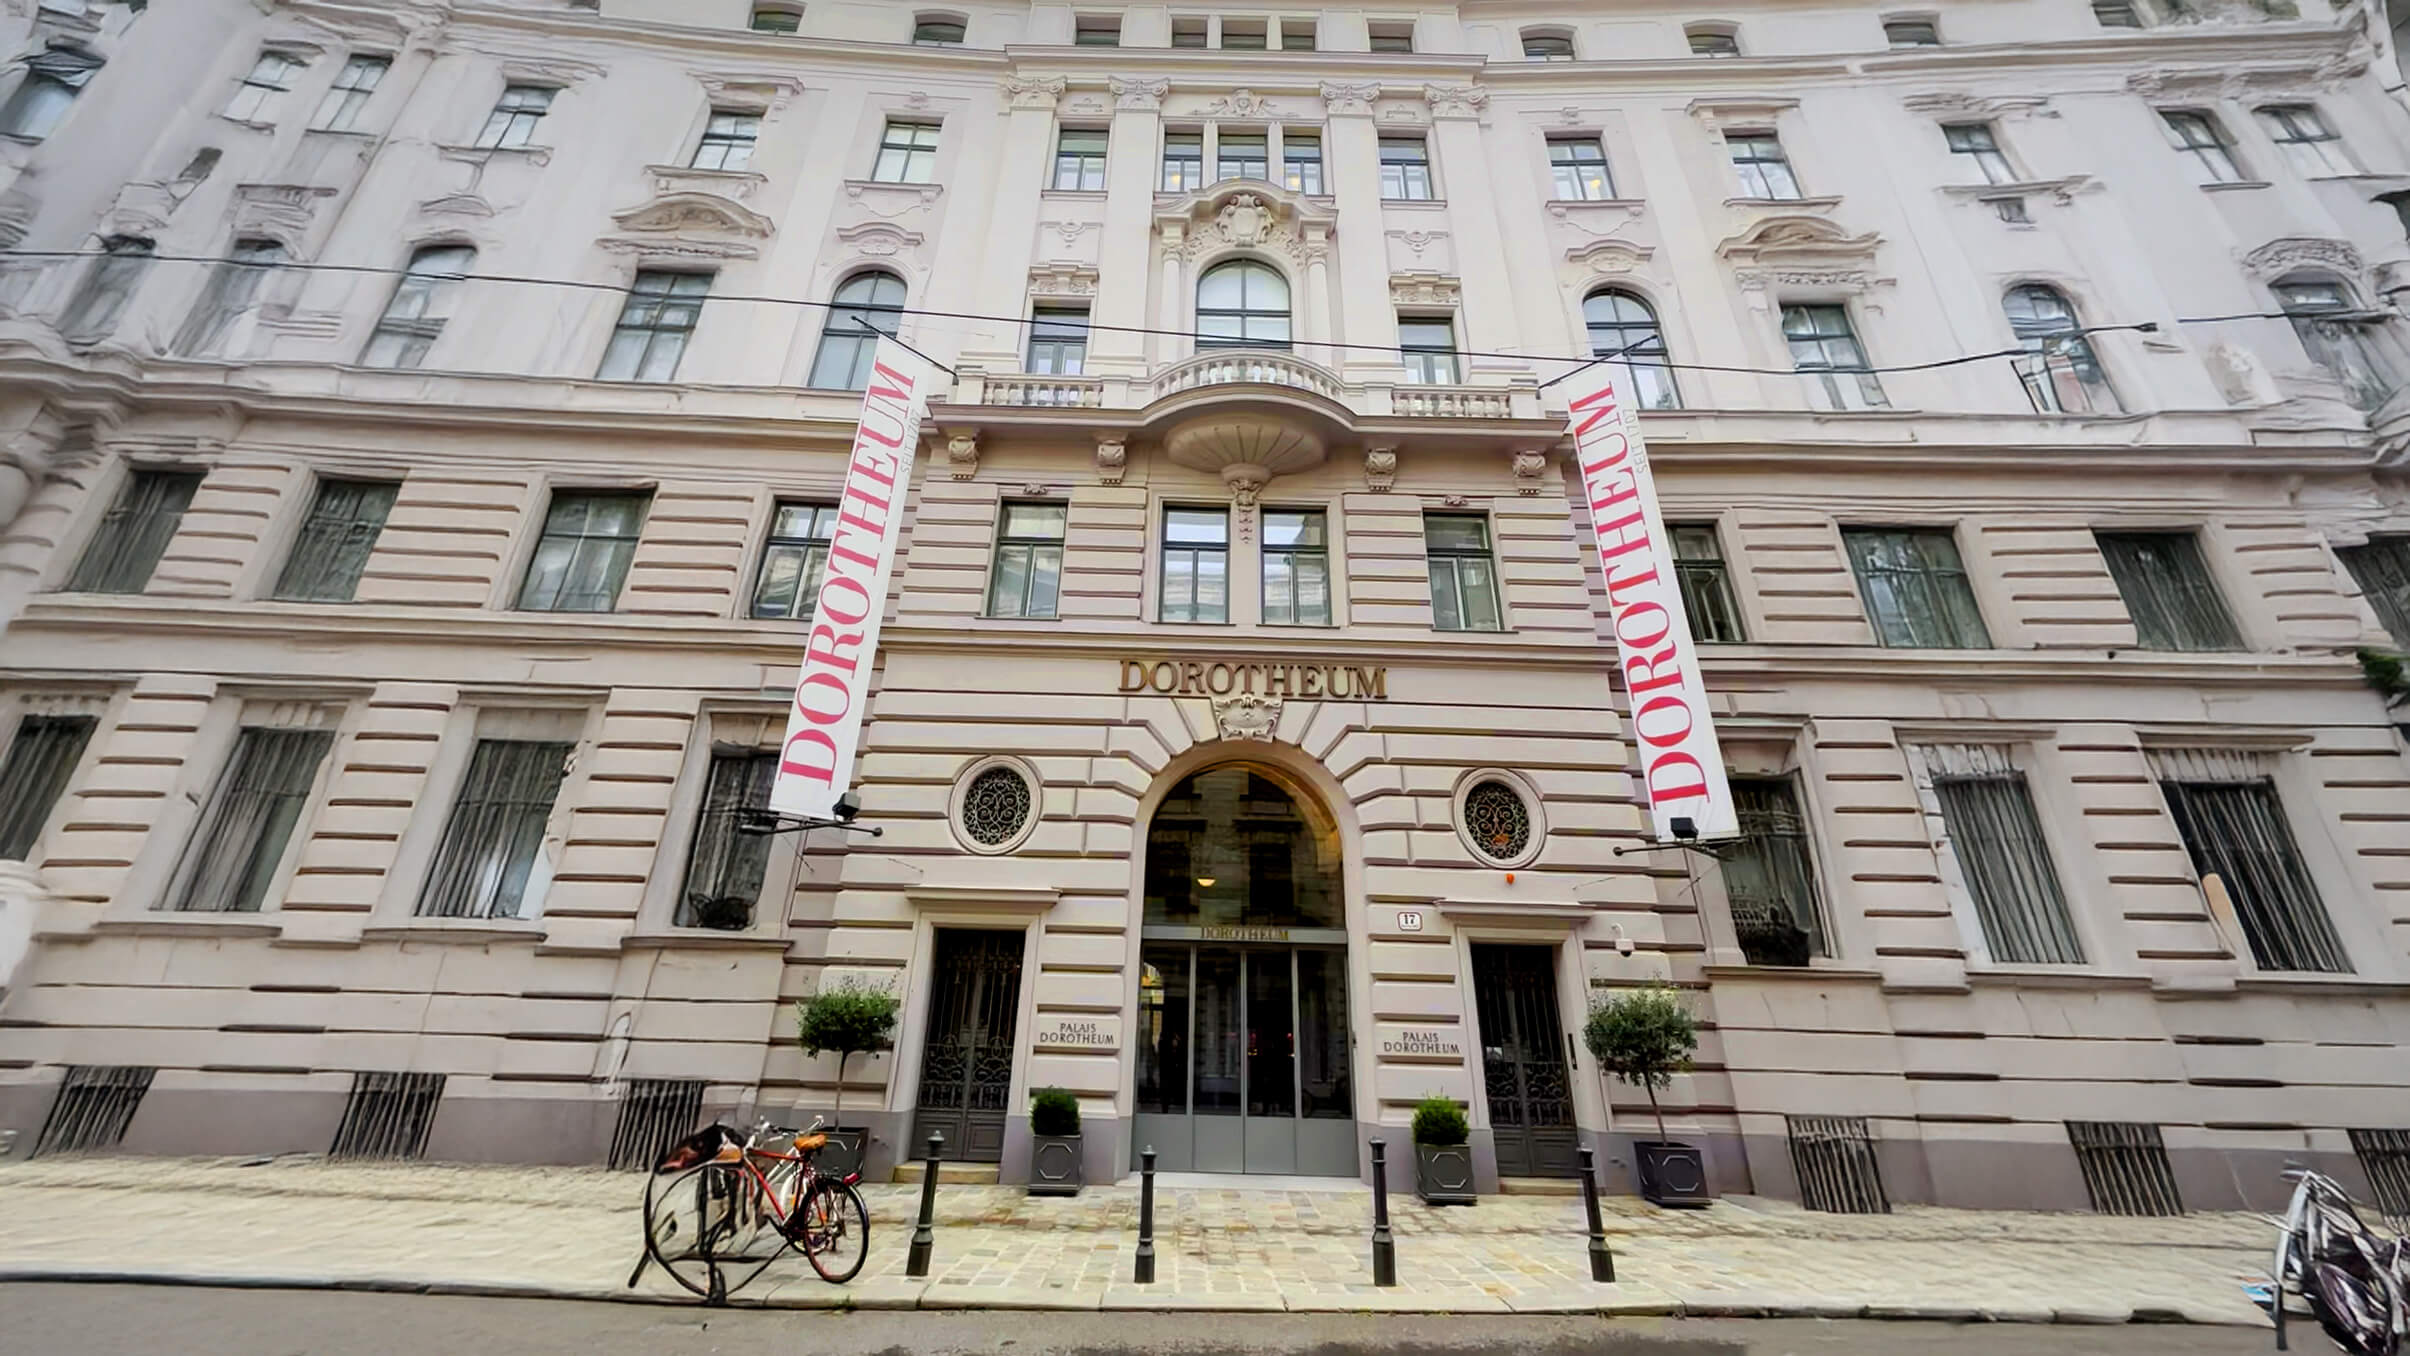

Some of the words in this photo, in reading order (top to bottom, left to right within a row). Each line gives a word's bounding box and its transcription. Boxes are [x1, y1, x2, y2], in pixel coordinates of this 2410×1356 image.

[1622, 408, 1642, 439] 1707
[900, 441, 913, 473] SEIT
[1631, 443, 1649, 474] SEIT
[779, 356, 916, 790] DOROTHEUM
[1568, 381, 1710, 811] DOROTHEUM
[1118, 659, 1388, 699] DOROTHEUM
[1404, 914, 1416, 925] 17
[1200, 927, 1289, 941] DOROTHEUM
[1040, 1032, 1114, 1044] DOROTHEUM
[1060, 1023, 1097, 1033] PALAIS
[1402, 1032, 1440, 1042] PALAIS
[1384, 1041, 1460, 1054] DOROTHEUM
